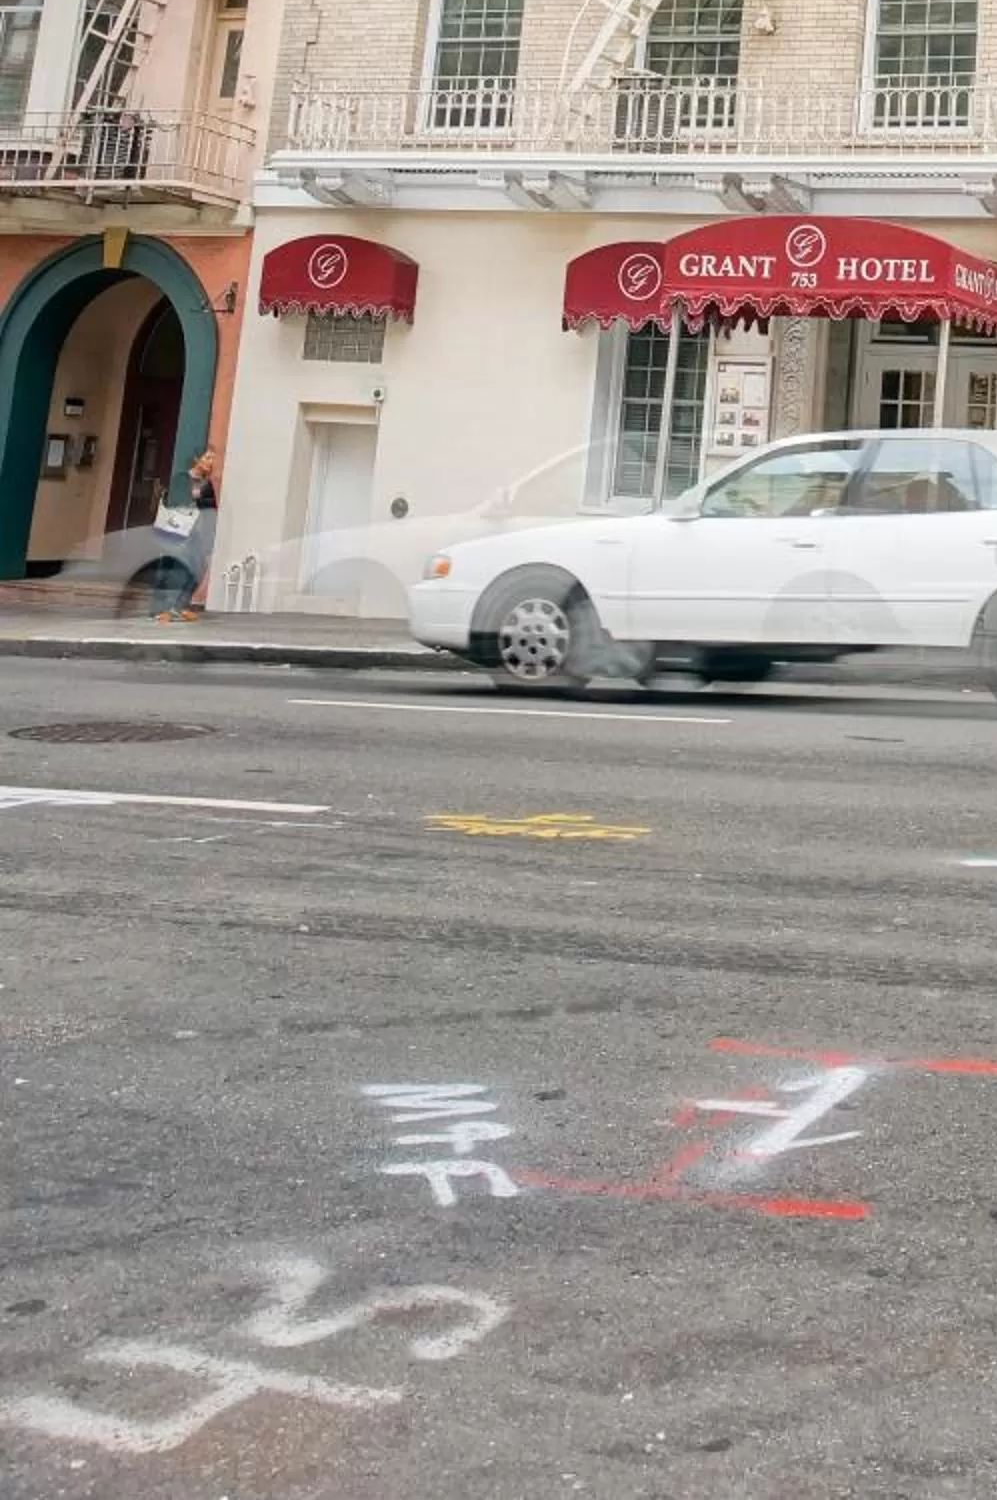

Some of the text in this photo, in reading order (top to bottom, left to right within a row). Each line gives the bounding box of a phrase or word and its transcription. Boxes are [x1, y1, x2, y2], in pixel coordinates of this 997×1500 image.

[679, 253, 935, 282] GRANT HOTEL
[791, 272, 817, 288] 753
[955, 263, 985, 295] GRANT
